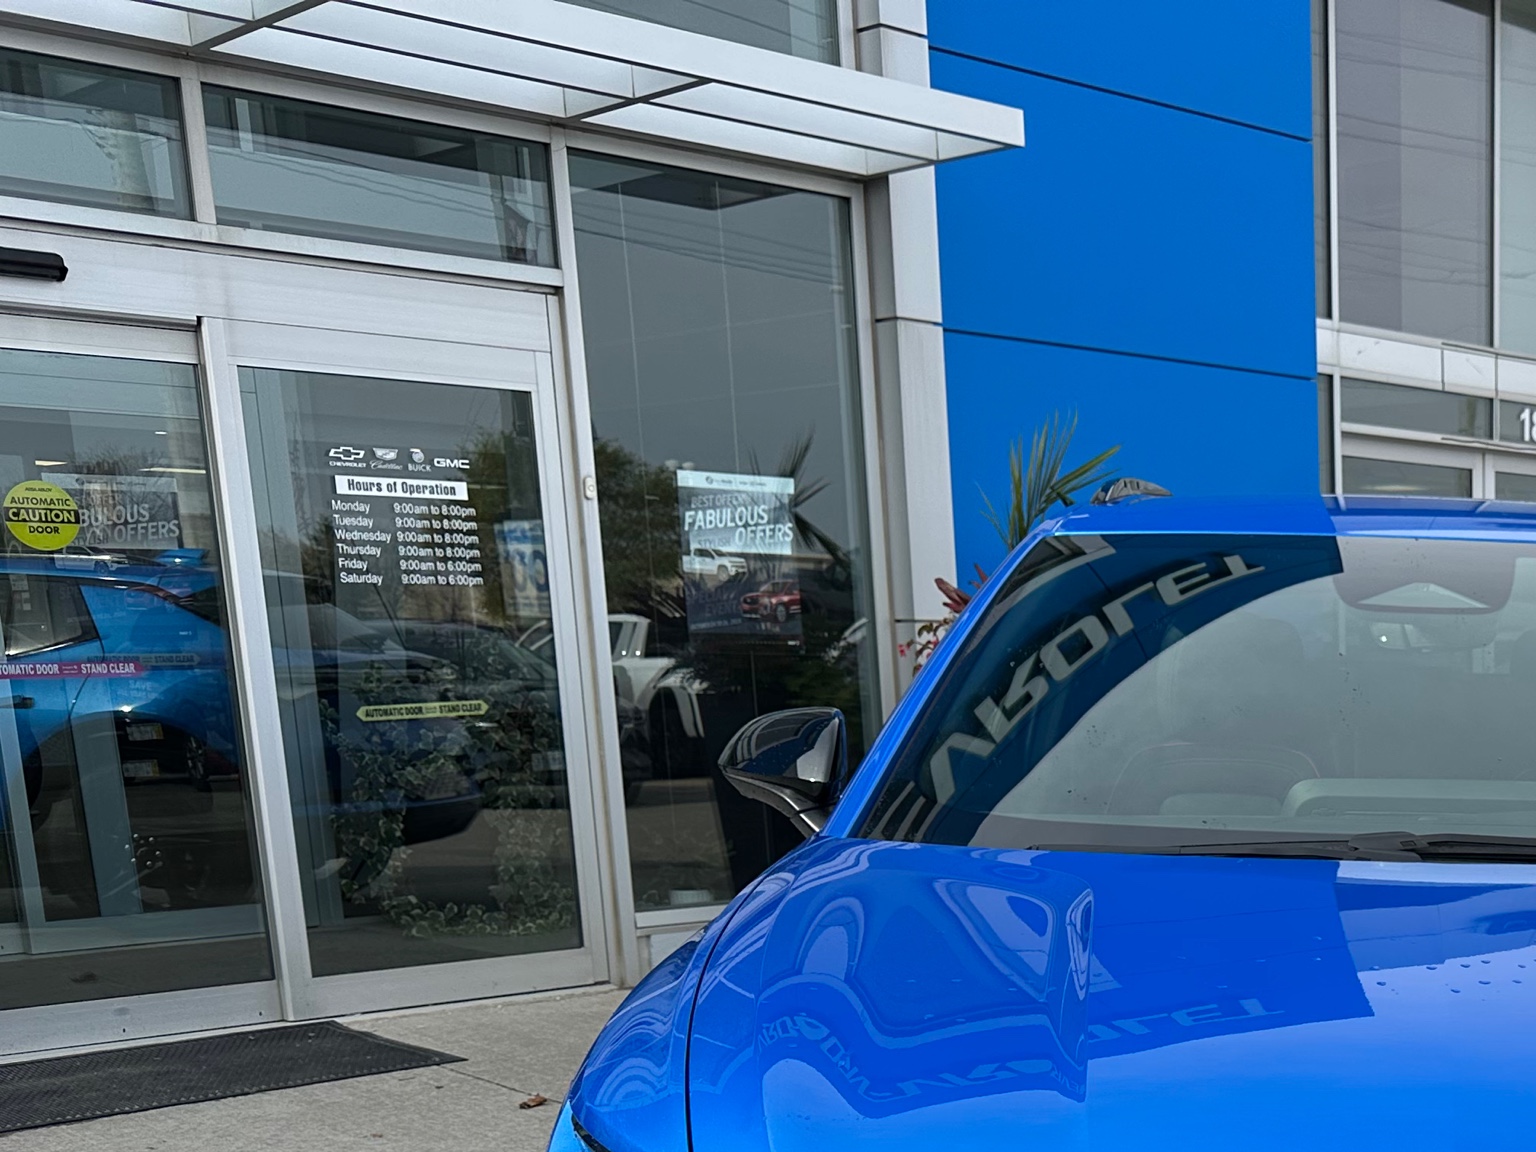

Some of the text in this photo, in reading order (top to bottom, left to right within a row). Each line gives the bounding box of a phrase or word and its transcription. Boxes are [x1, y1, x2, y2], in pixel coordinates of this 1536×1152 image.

[408, 463, 431, 472] BUICK
[434, 458, 470, 469] GMC
[347, 479, 456, 496] Hours of Operation
[10, 496, 71, 507] AUTOMATIC
[332, 499, 476, 517] Monday 9:00am to 8:00pm
[8, 509, 75, 522] CAUTION
[333, 515, 477, 531] Tuesday 9:00am to 8:00pm
[684, 505, 768, 531] FABULOUS
[29, 525, 60, 534] DOOR
[114, 520, 179, 542] OFFERS
[735, 523, 793, 546] OFFERS
[335, 530, 479, 545] Wednesday 9:00am to 8:00pm
[336, 544, 480, 559] Thursday 9:00am to 8:00pm
[338, 559, 482, 573] Friday 9:00am to 6:00pm
[340, 573, 484, 587] Saturday 9:00am to 6:00pm
[36, 664, 59, 675] DOOR
[81, 663, 108, 674] STAND
[109, 663, 135, 674] CLEAR
[365, 708, 404, 718] AUTOMATIC
[405, 706, 424, 716] DOOR
[438, 704, 460, 714] STAND
[461, 703, 482, 712] CLEAR
